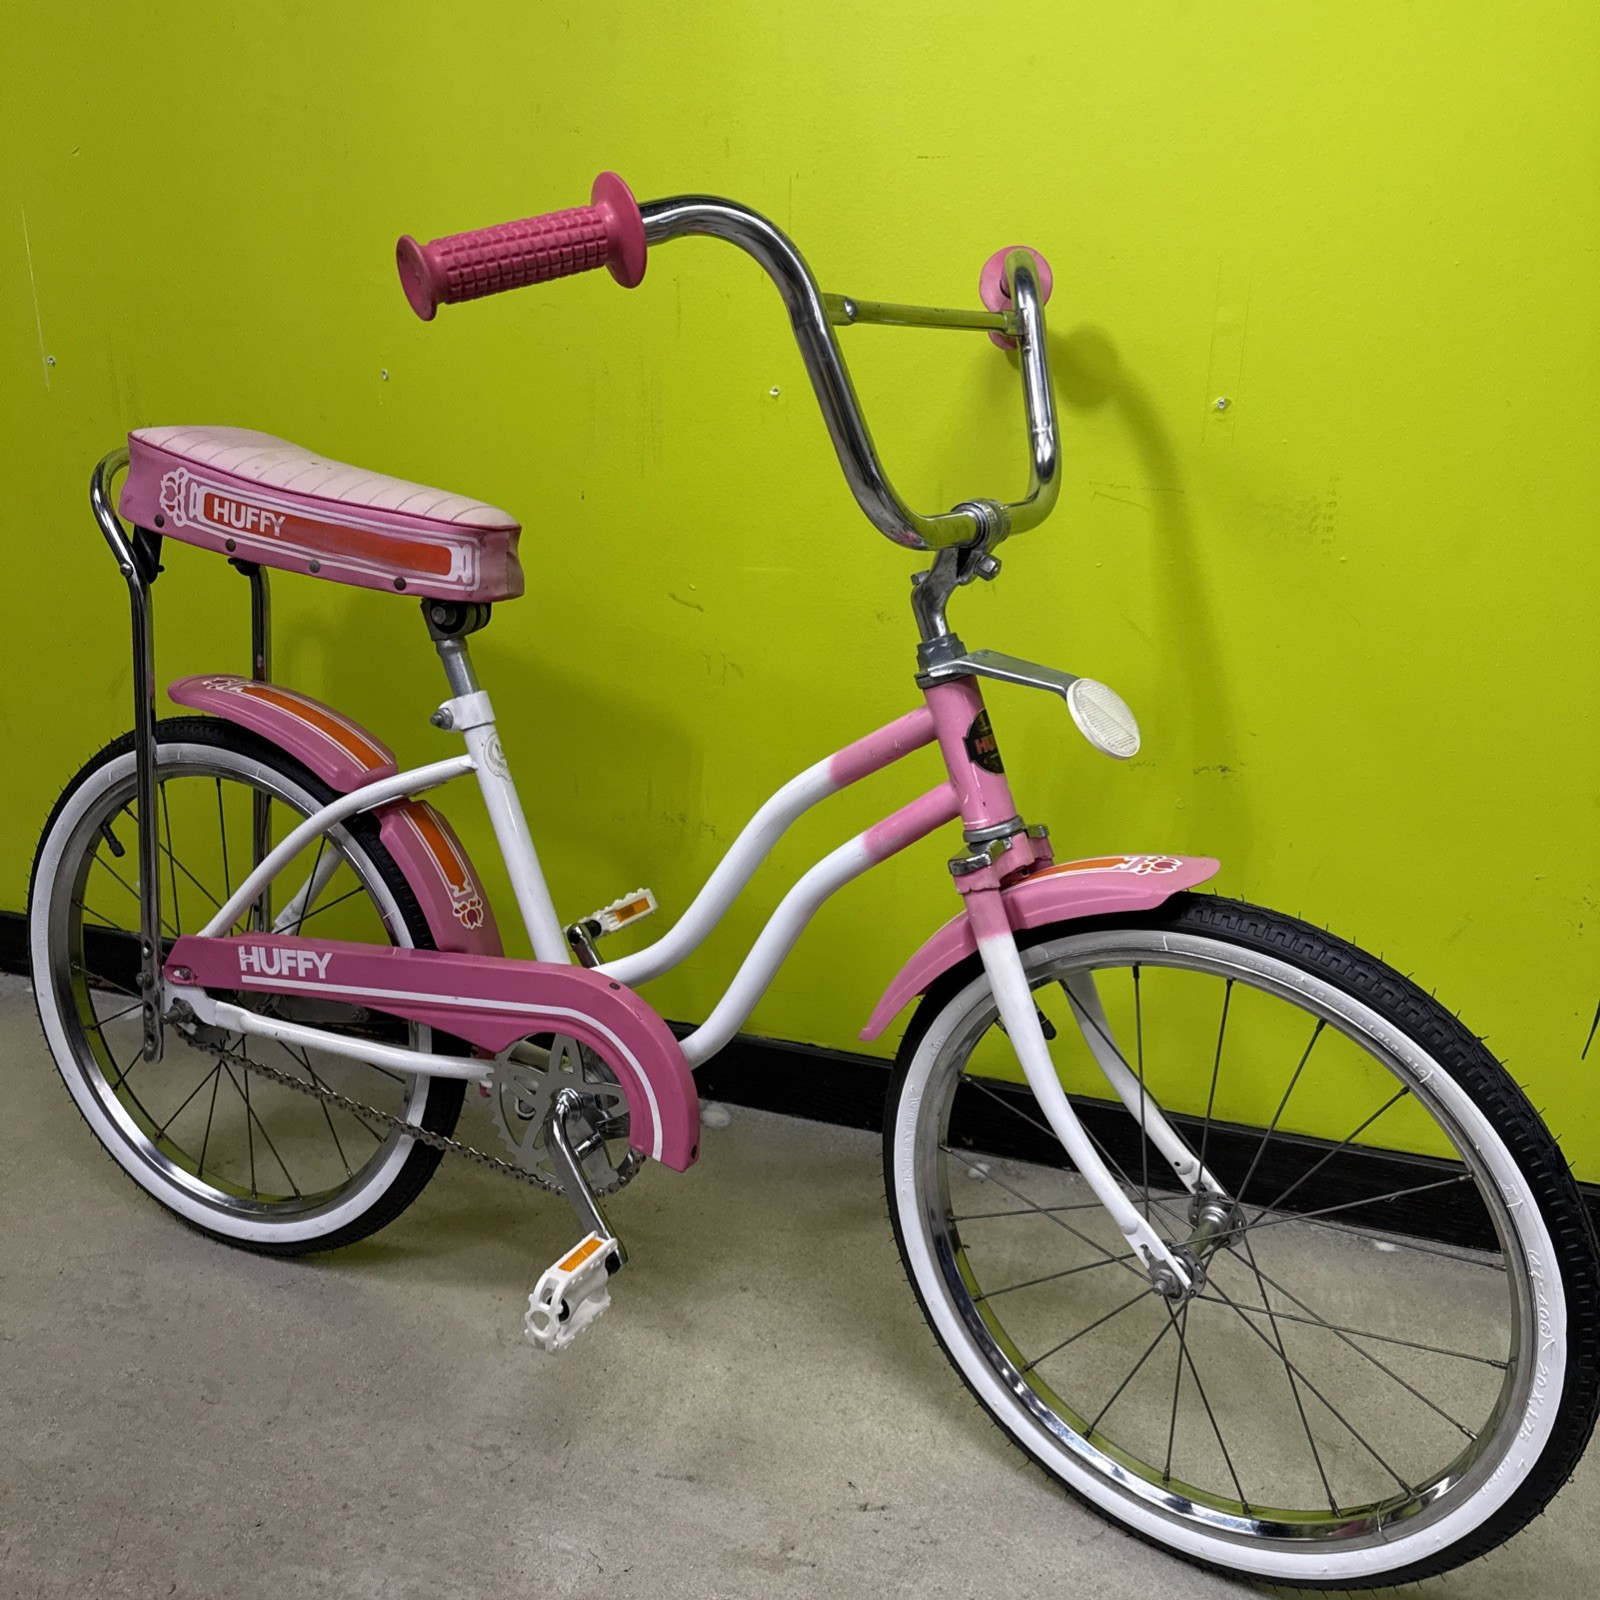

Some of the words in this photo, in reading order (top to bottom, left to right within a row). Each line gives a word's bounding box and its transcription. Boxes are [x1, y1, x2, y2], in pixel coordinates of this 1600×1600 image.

[213, 497, 286, 537] HUFFY
[238, 945, 333, 979] HUFFY
[903, 1098, 921, 1184] KENDA
